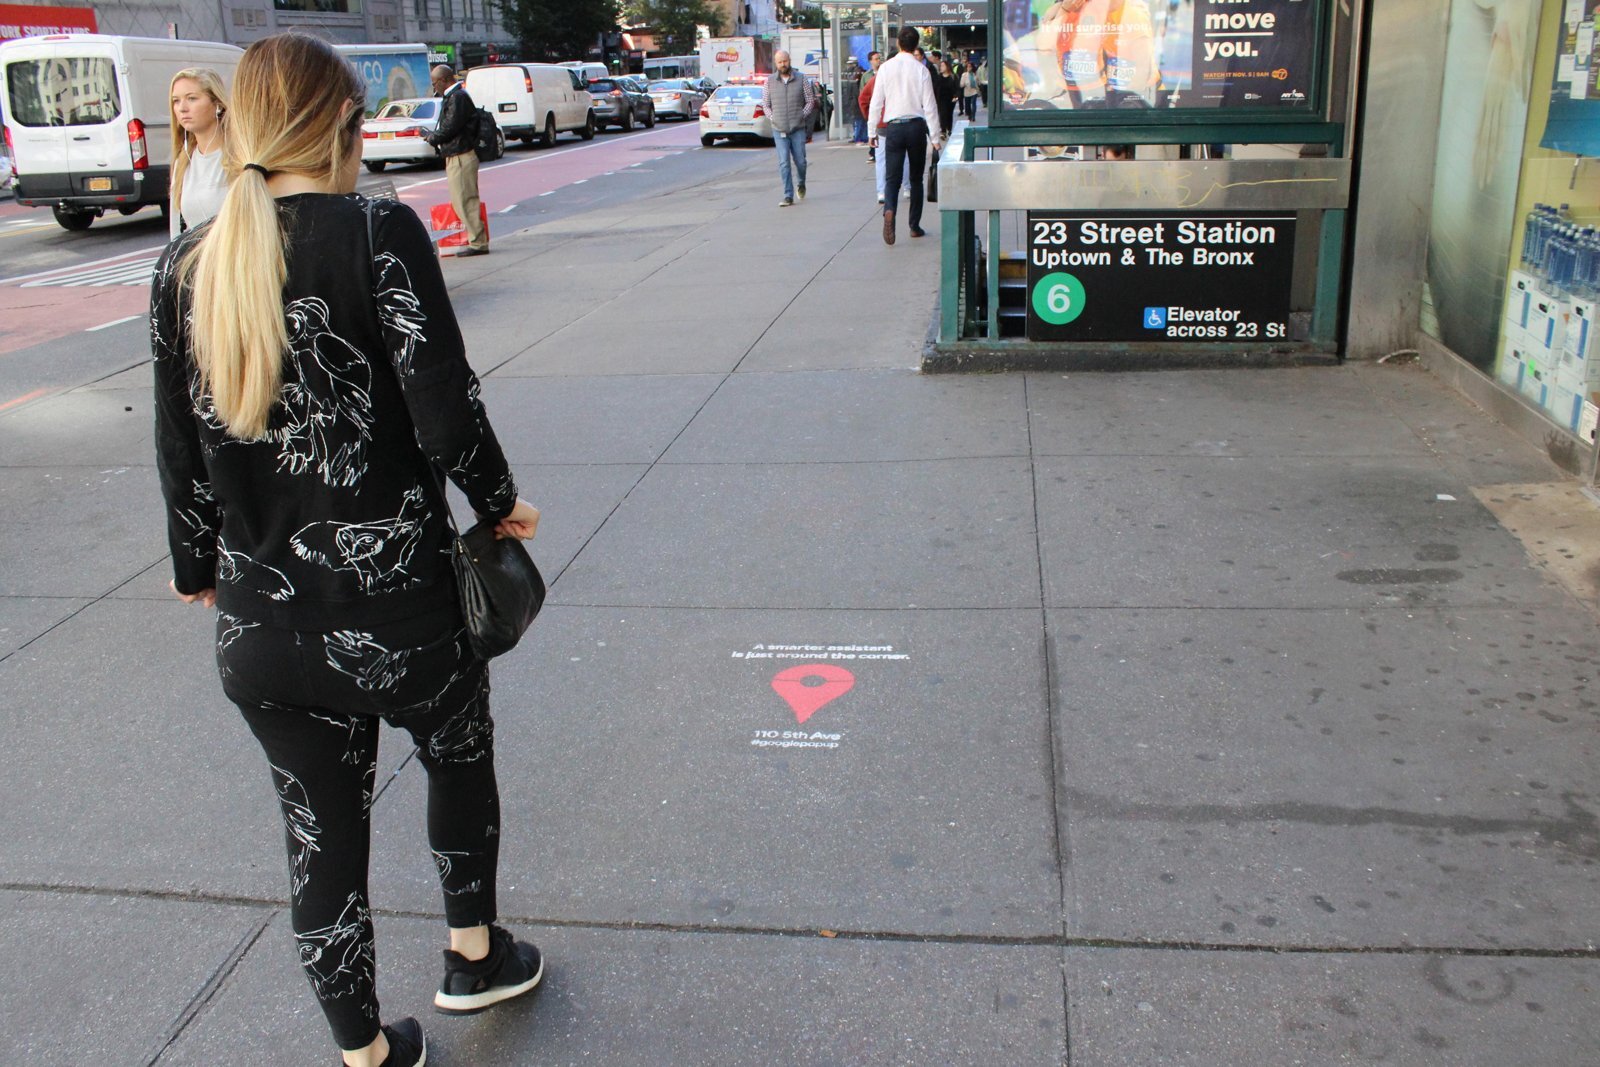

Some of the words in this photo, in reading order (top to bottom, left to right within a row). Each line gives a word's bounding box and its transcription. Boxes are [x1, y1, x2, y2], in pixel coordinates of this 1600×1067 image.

[941, 4, 957, 15] Blue
[958, 4, 975, 19] Dog
[1054, 22, 1074, 32] will
[1076, 23, 1122, 34] surprise
[1205, 12, 1275, 29] move
[0, 25, 22, 38] ORK
[22, 25, 60, 37] SPORTS
[1203, 41, 1258, 61] you.
[353, 61, 383, 84] ICO
[1033, 222, 1067, 245] 23
[1080, 221, 1165, 244] Street
[1177, 220, 1276, 244] Station
[1032, 249, 1111, 269] Uptown
[1121, 248, 1136, 265] &
[1145, 248, 1184, 265] The
[1193, 248, 1255, 265] Bronx
[1047, 284, 1071, 313] 6
[1167, 307, 1241, 322] Elevator
[1166, 324, 1227, 338] across
[1235, 322, 1258, 337] 23
[1265, 322, 1286, 337] St
[745, 651, 774, 660] just
[830, 652, 856, 660] the
[858, 652, 911, 660] corner.
[827, 644, 894, 652] assistant
[754, 730, 779, 738] 110
[782, 730, 808, 739] 5th
[809, 731, 841, 740] Ave
[751, 739, 839, 748] #googlepopup
